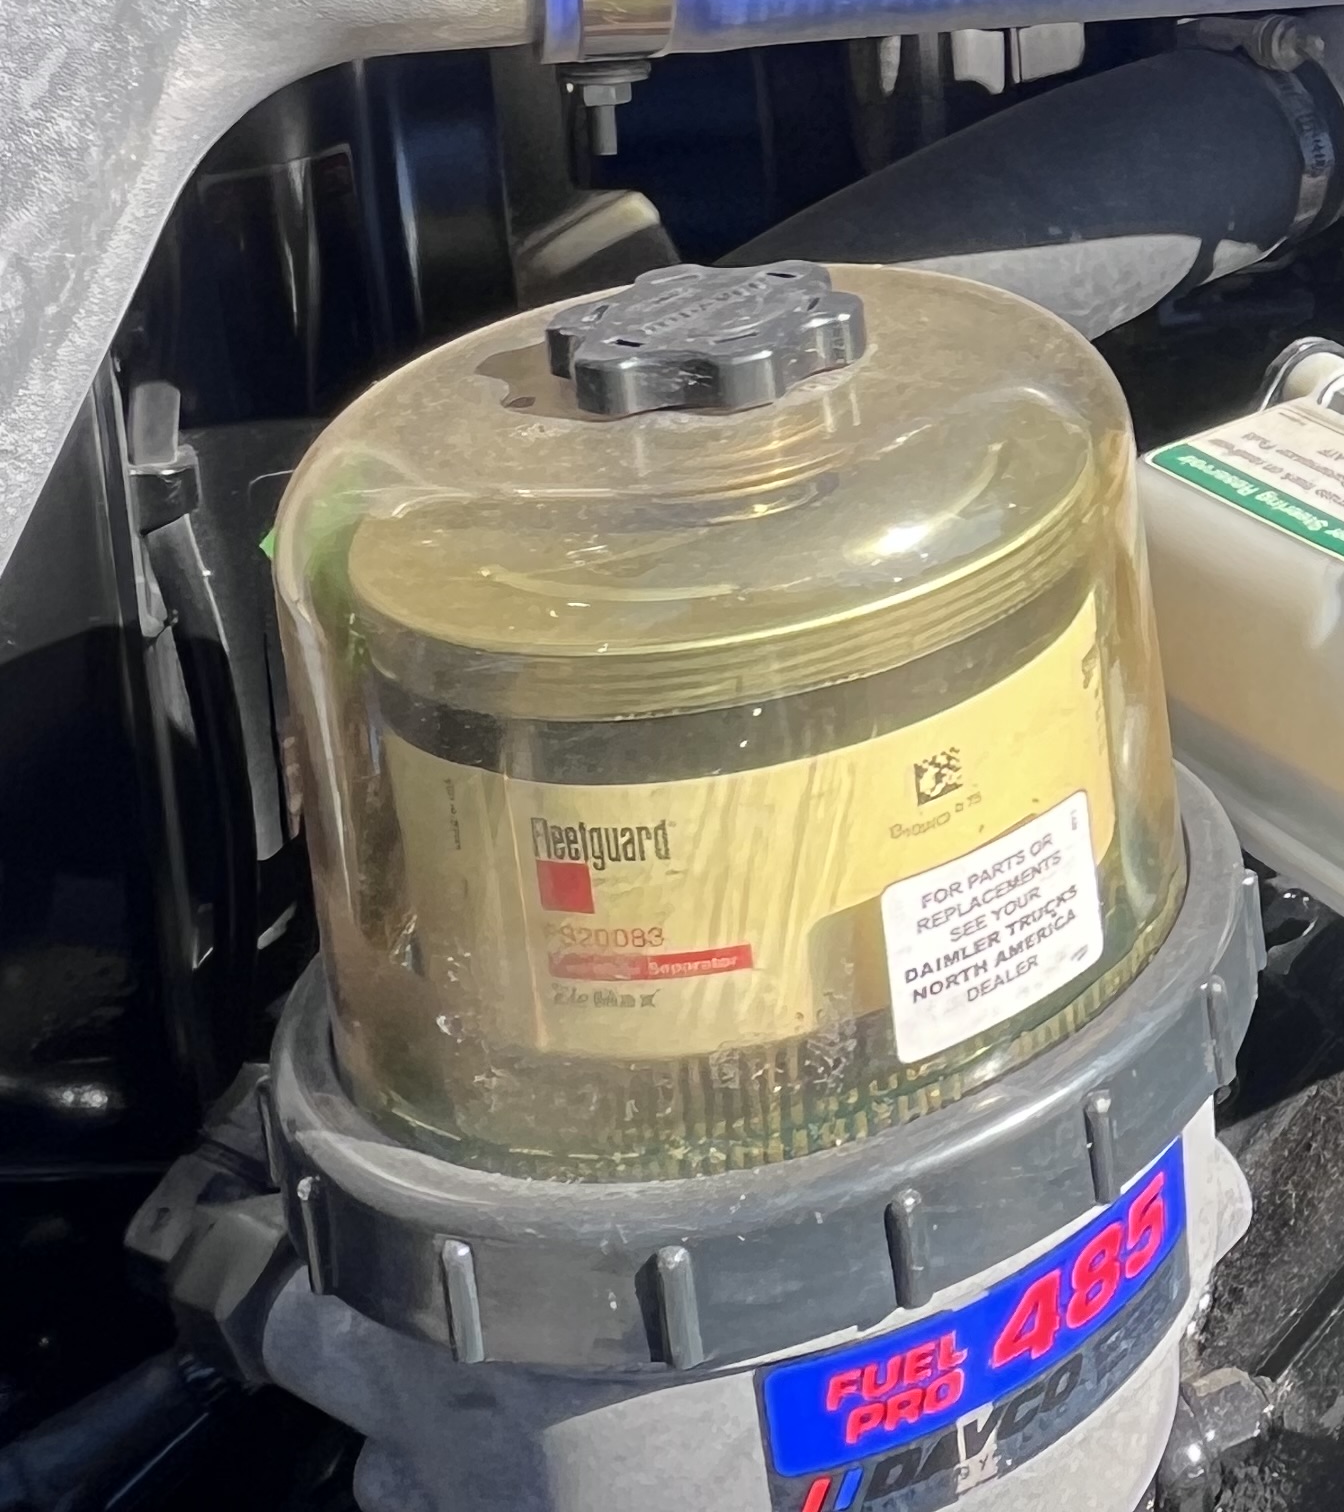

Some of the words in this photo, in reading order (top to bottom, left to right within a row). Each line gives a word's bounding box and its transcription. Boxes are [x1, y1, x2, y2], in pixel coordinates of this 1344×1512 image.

[1176, 454, 1259, 497] Reservoir
[1254, 488, 1328, 532] Steering
[530, 817, 671, 870] Fleetguard
[920, 880, 965, 909] FOR
[966, 849, 1026, 890] PARTS
[1028, 832, 1054, 857] OR
[915, 849, 1063, 936] REPLACEMENTS
[949, 913, 989, 943] SEE
[990, 885, 1043, 922] YOUR
[646, 954, 738, 975] Separator
[904, 929, 1001, 985] DAIMLER
[1004, 883, 1079, 937] TRUCKS
[911, 958, 990, 1004] NORTH
[993, 907, 1078, 969] AMERICA
[966, 953, 1040, 1003] DEALER
[826, 1331, 968, 1412] FUEL
[990, 1170, 1166, 1370] 485
[845, 1368, 966, 1445] PRO
